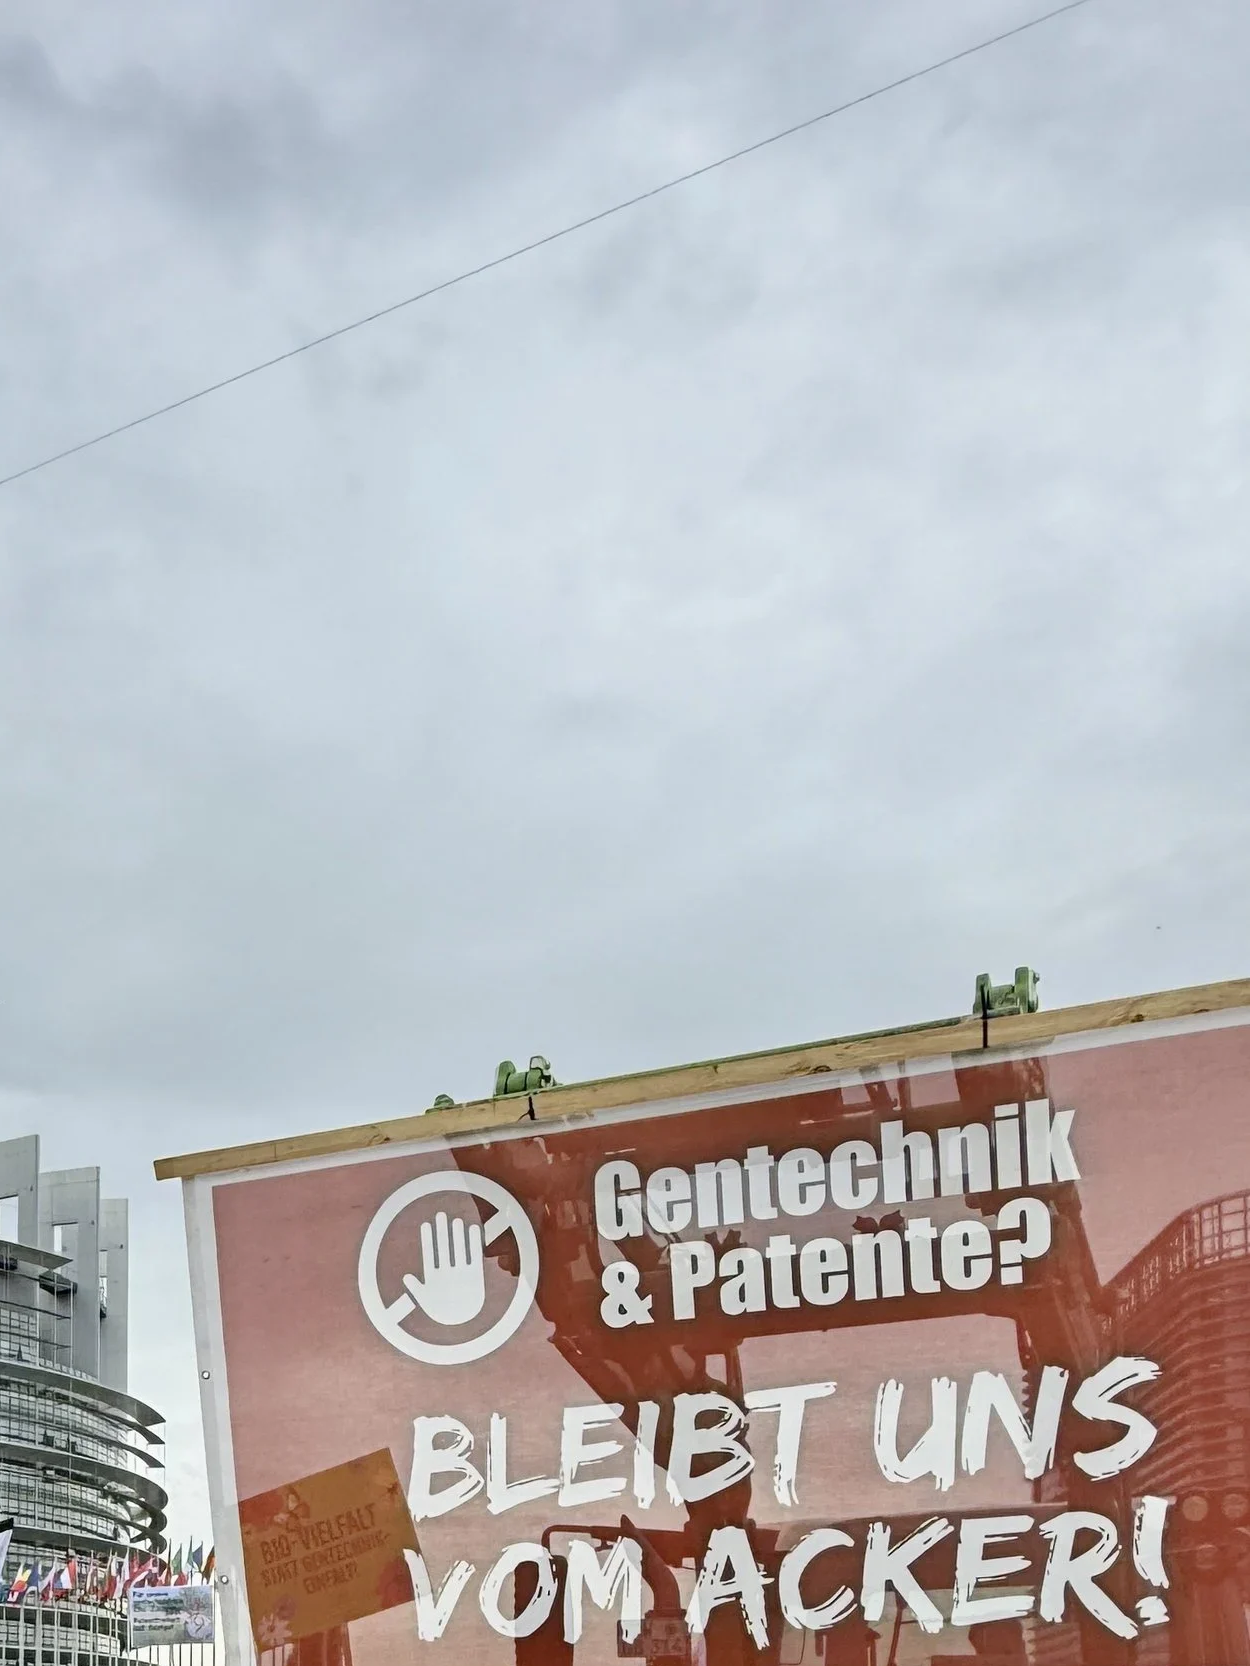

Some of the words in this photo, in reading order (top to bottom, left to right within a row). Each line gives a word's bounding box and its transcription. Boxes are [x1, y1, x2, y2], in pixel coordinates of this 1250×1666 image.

[594, 1099, 1081, 1240] Gentechnik
[600, 1258, 655, 1328] &
[671, 1197, 1051, 1321] Patente?
[408, 1380, 837, 1521] BLEIBT
[873, 1356, 1160, 1491] UNS
[402, 1534, 655, 1642] VOM
[687, 1495, 1170, 1649] ACKER!
